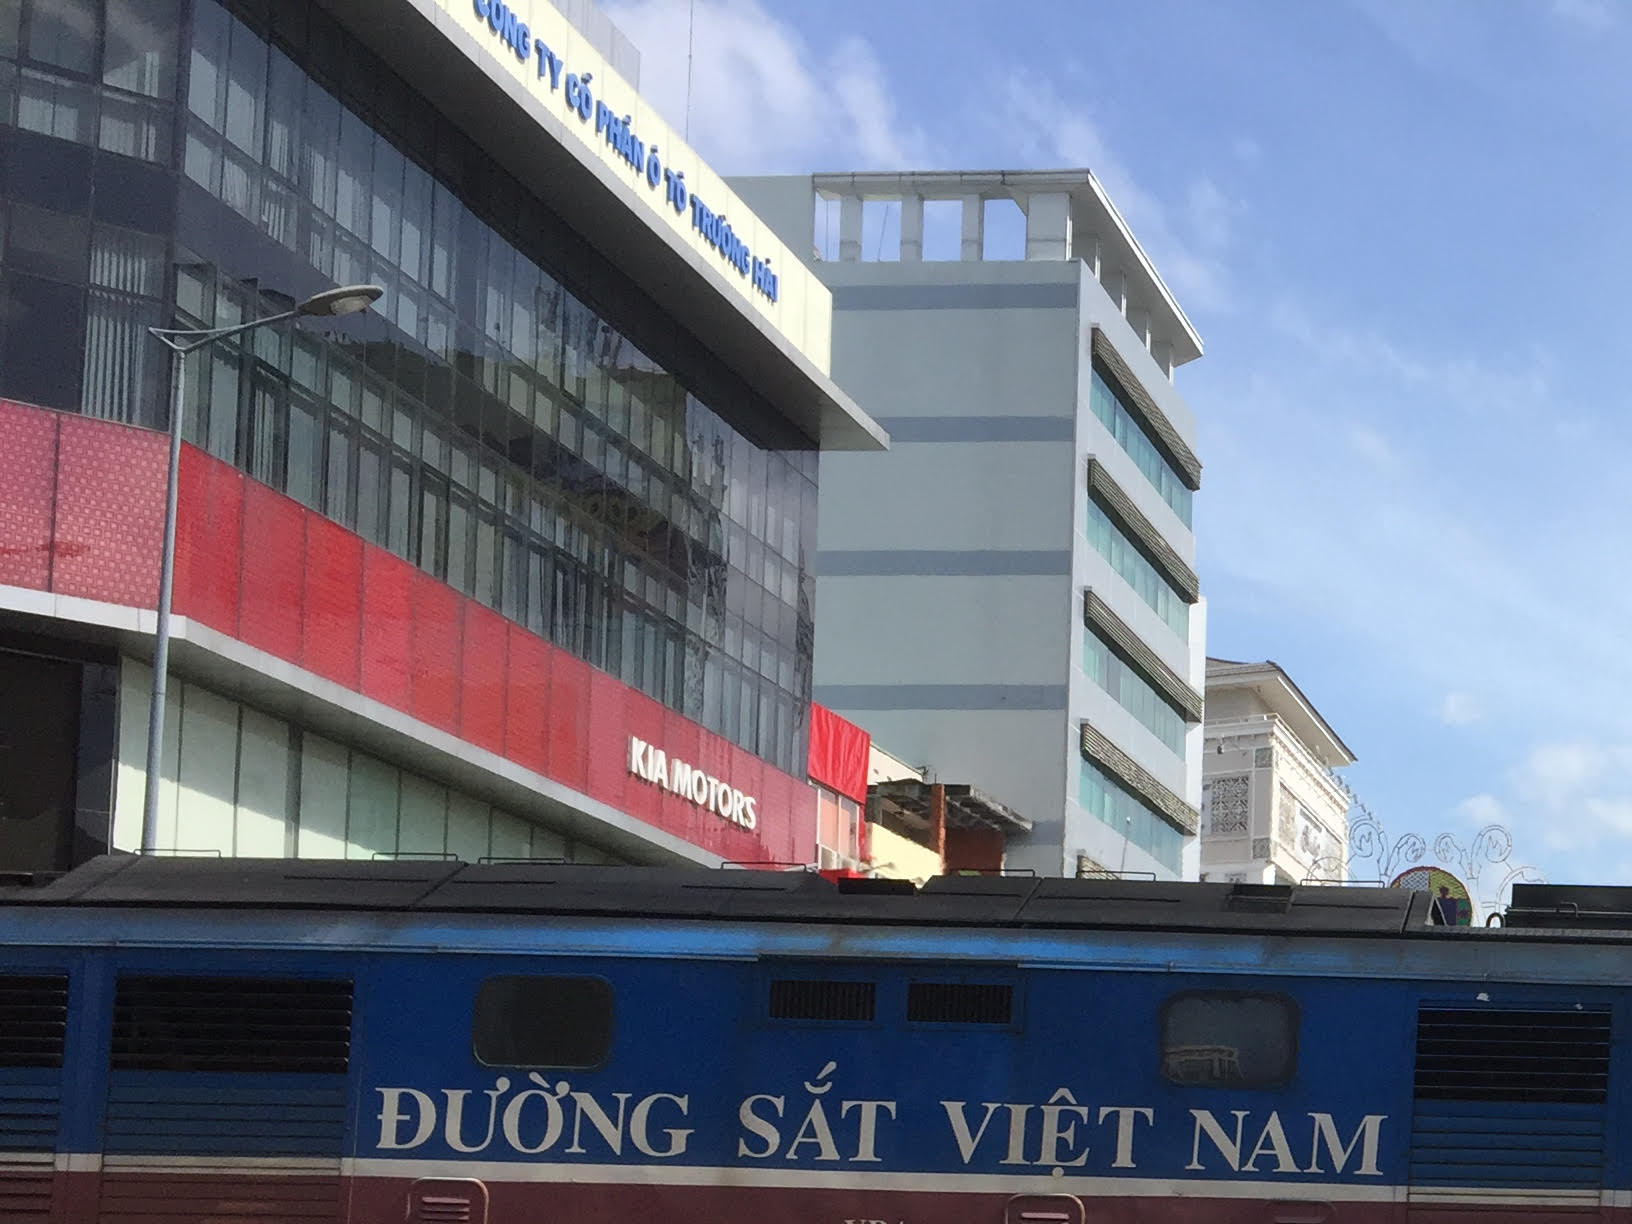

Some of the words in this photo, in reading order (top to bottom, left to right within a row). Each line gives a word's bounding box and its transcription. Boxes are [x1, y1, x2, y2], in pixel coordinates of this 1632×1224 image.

[534, 38, 564, 92] TY
[626, 735, 669, 790] KIA
[669, 757, 758, 831] MOTORS
[375, 1071, 695, 1158] ĐƯỜNG
[737, 1060, 897, 1163] SẮT
[939, 1087, 1154, 1179] VIỆT
[1184, 1108, 1389, 1176] NAM
